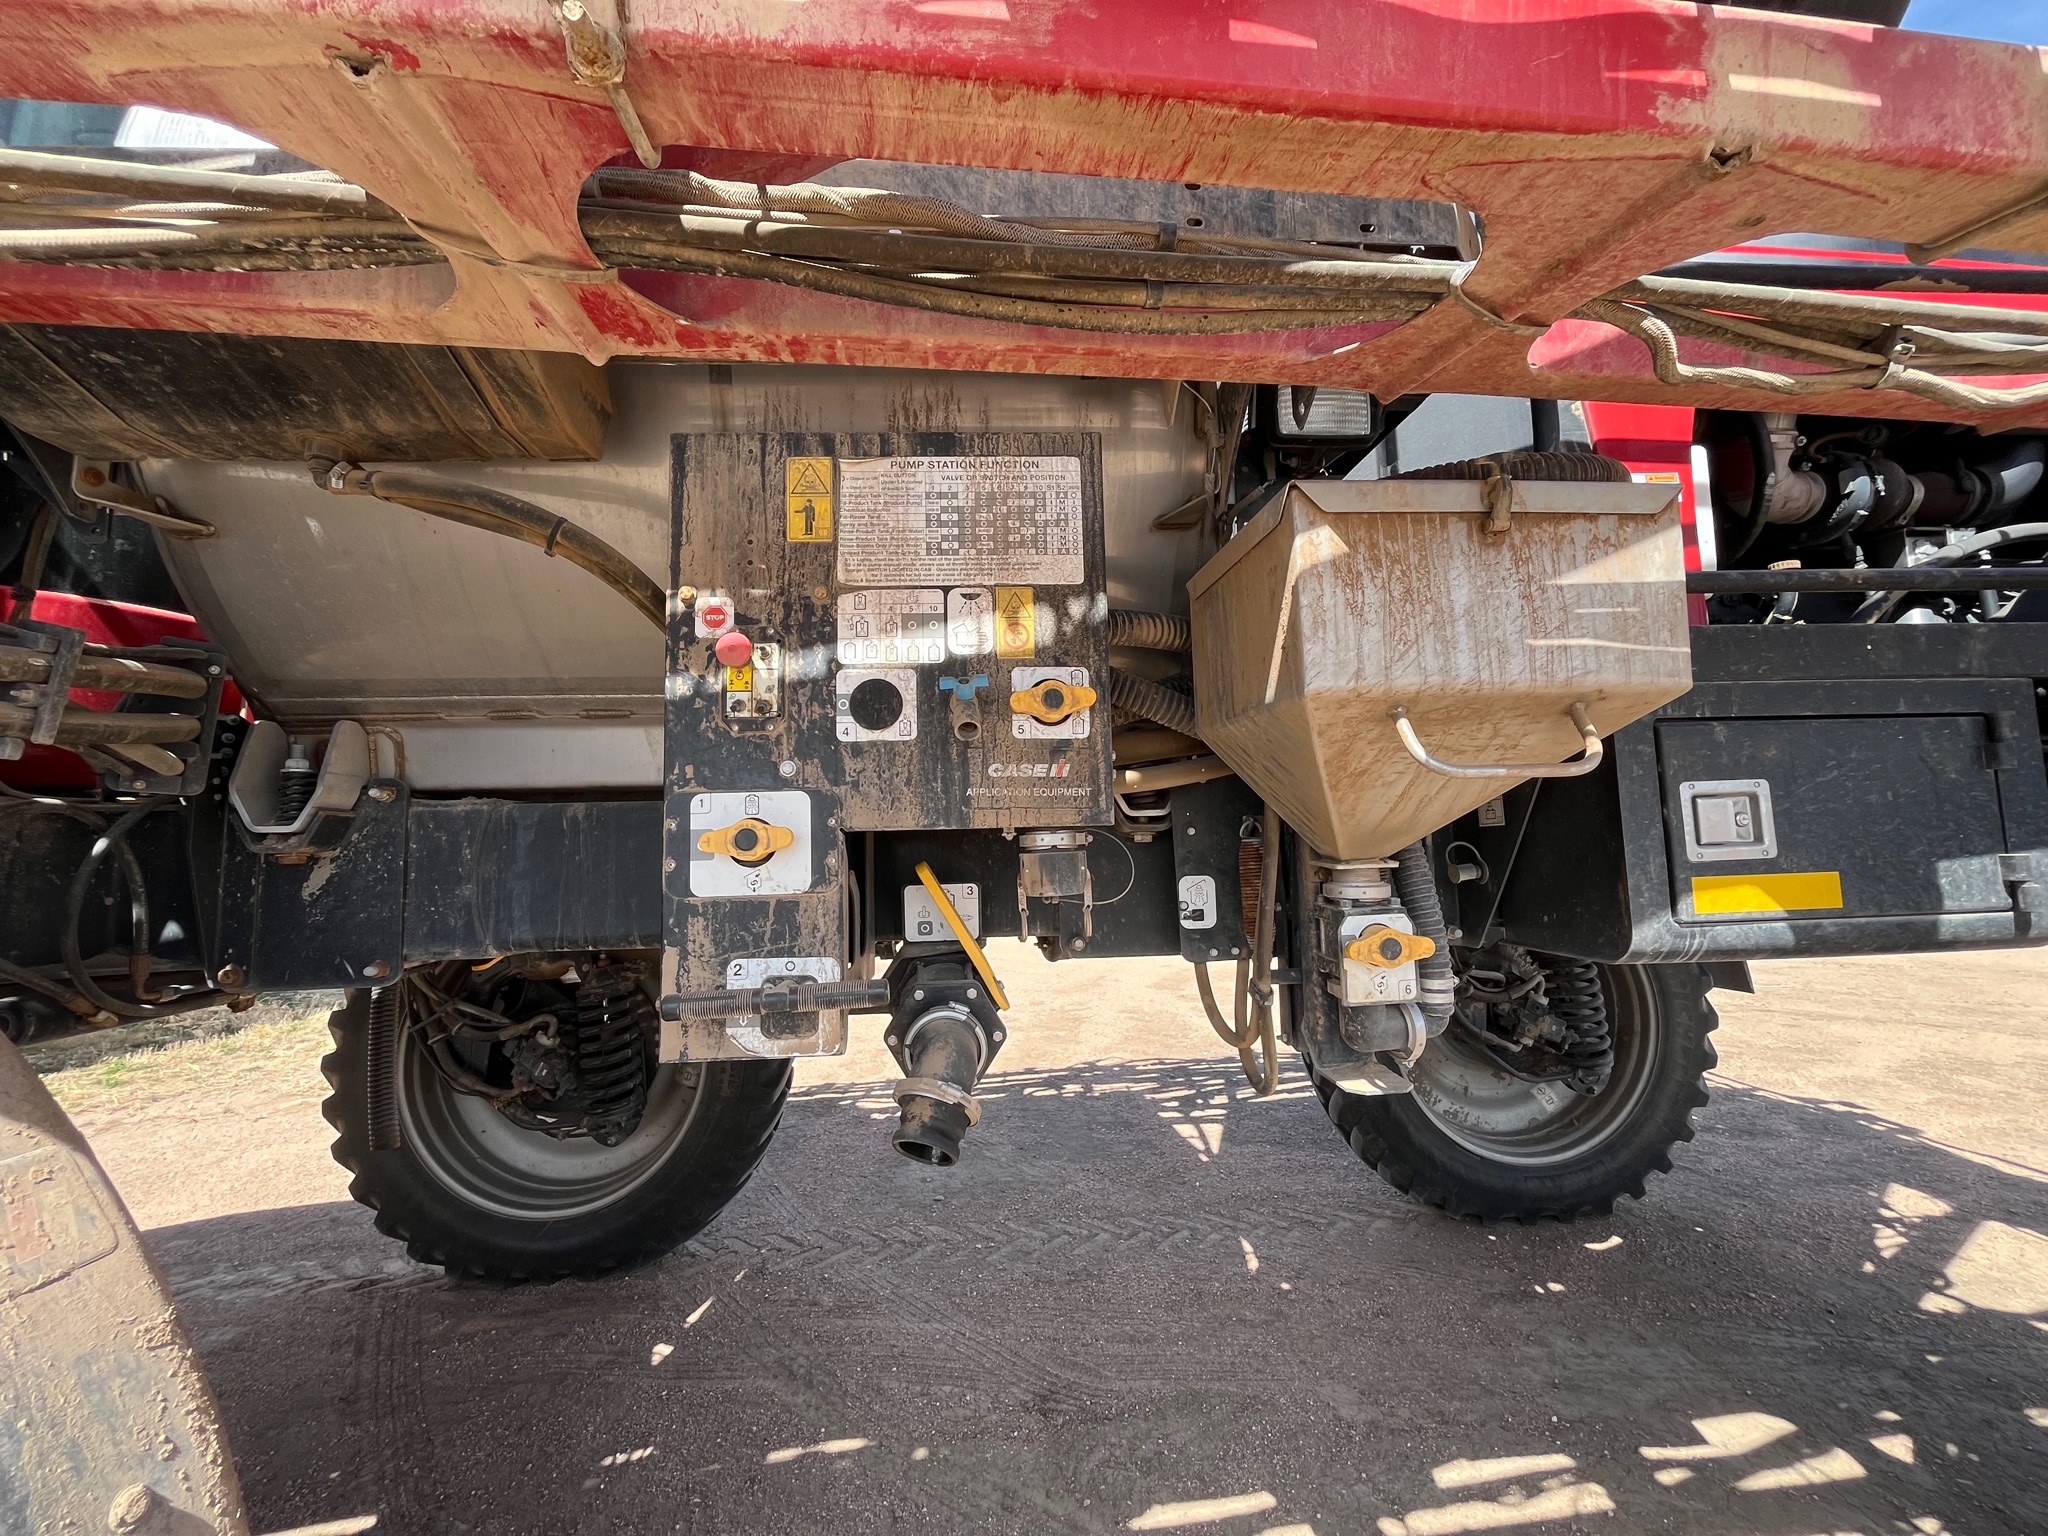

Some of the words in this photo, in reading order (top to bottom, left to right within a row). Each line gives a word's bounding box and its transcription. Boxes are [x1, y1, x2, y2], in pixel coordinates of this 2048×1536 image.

[891, 461, 924, 469] PUMP
[928, 461, 976, 469] STATION
[980, 461, 1039, 469] FUNCTION
[842, 727, 849, 737] 4
[1017, 724, 1025, 735] 5
[987, 763, 1049, 778] CASE
[1033, 788, 1092, 797] EQUIPMENT
[698, 798, 704, 808] 1
[966, 886, 974, 896] 3
[733, 963, 742, 976] 2
[1404, 984, 1412, 995] 6
